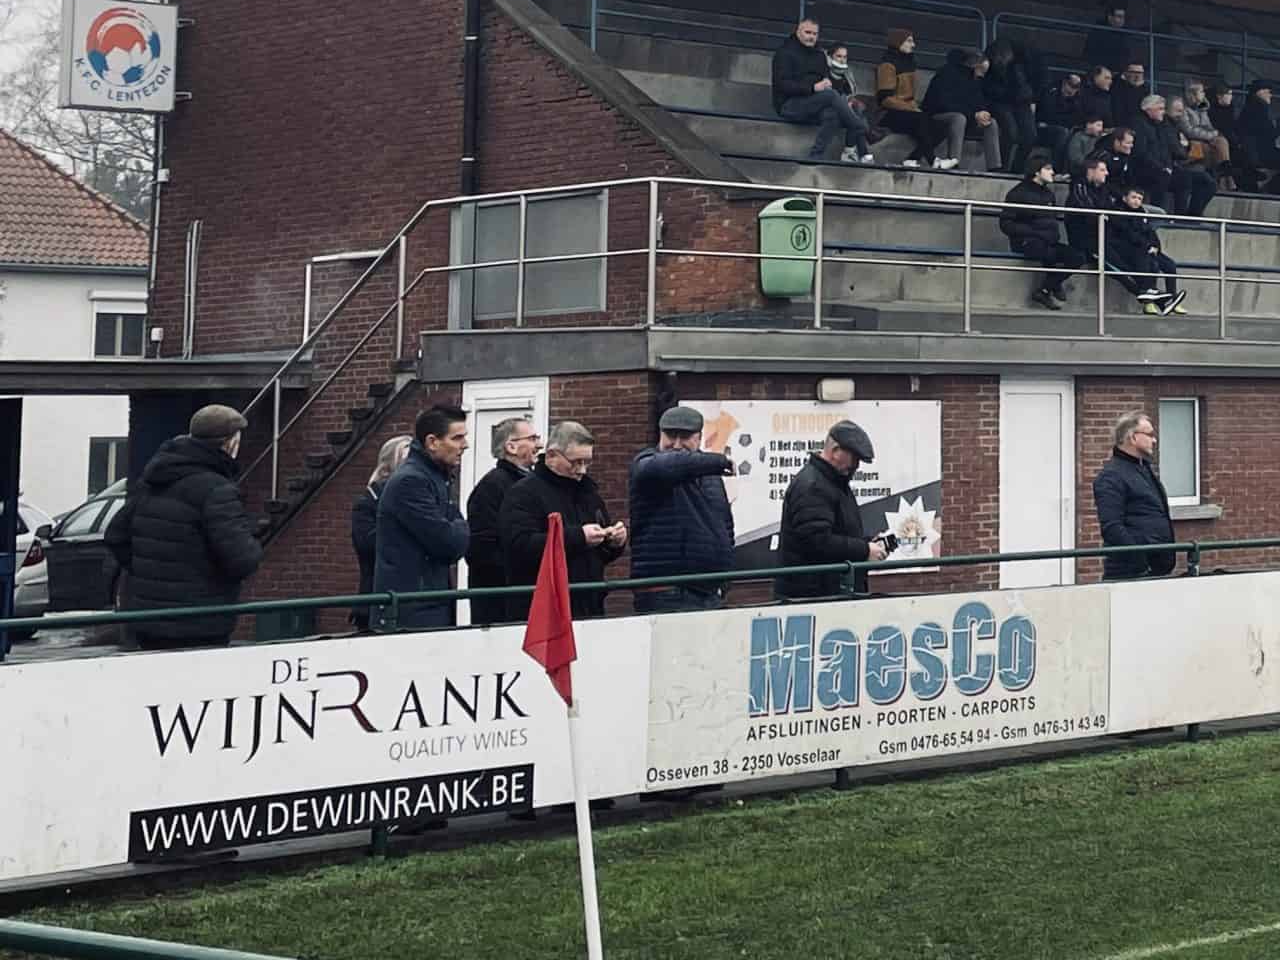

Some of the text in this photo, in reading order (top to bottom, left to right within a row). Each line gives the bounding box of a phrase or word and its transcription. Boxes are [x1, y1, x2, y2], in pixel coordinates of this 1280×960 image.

[75, 57, 172, 101] KFC LENTEZON
[271, 657, 310, 686] DE
[747, 601, 1038, 718] MaesCo
[144, 669, 530, 765] WIJNRANK
[747, 696, 1037, 742] AFSLUITINGEN POORTEN CARPORTS
[879, 739, 908, 755] Gsm
[976, 729, 991, 743] 94
[1000, 725, 1028, 740] Gsm
[1033, 719, 1075, 737] 0476-31
[1078, 716, 1091, 731] 43
[1093, 714, 1106, 729] 49
[388, 727, 529, 763] QUALITY WINES
[646, 747, 842, 783] Osseven 38 2350 Vosselaar
[140, 771, 527, 853] WWW.DEWIJNRANK.BE
